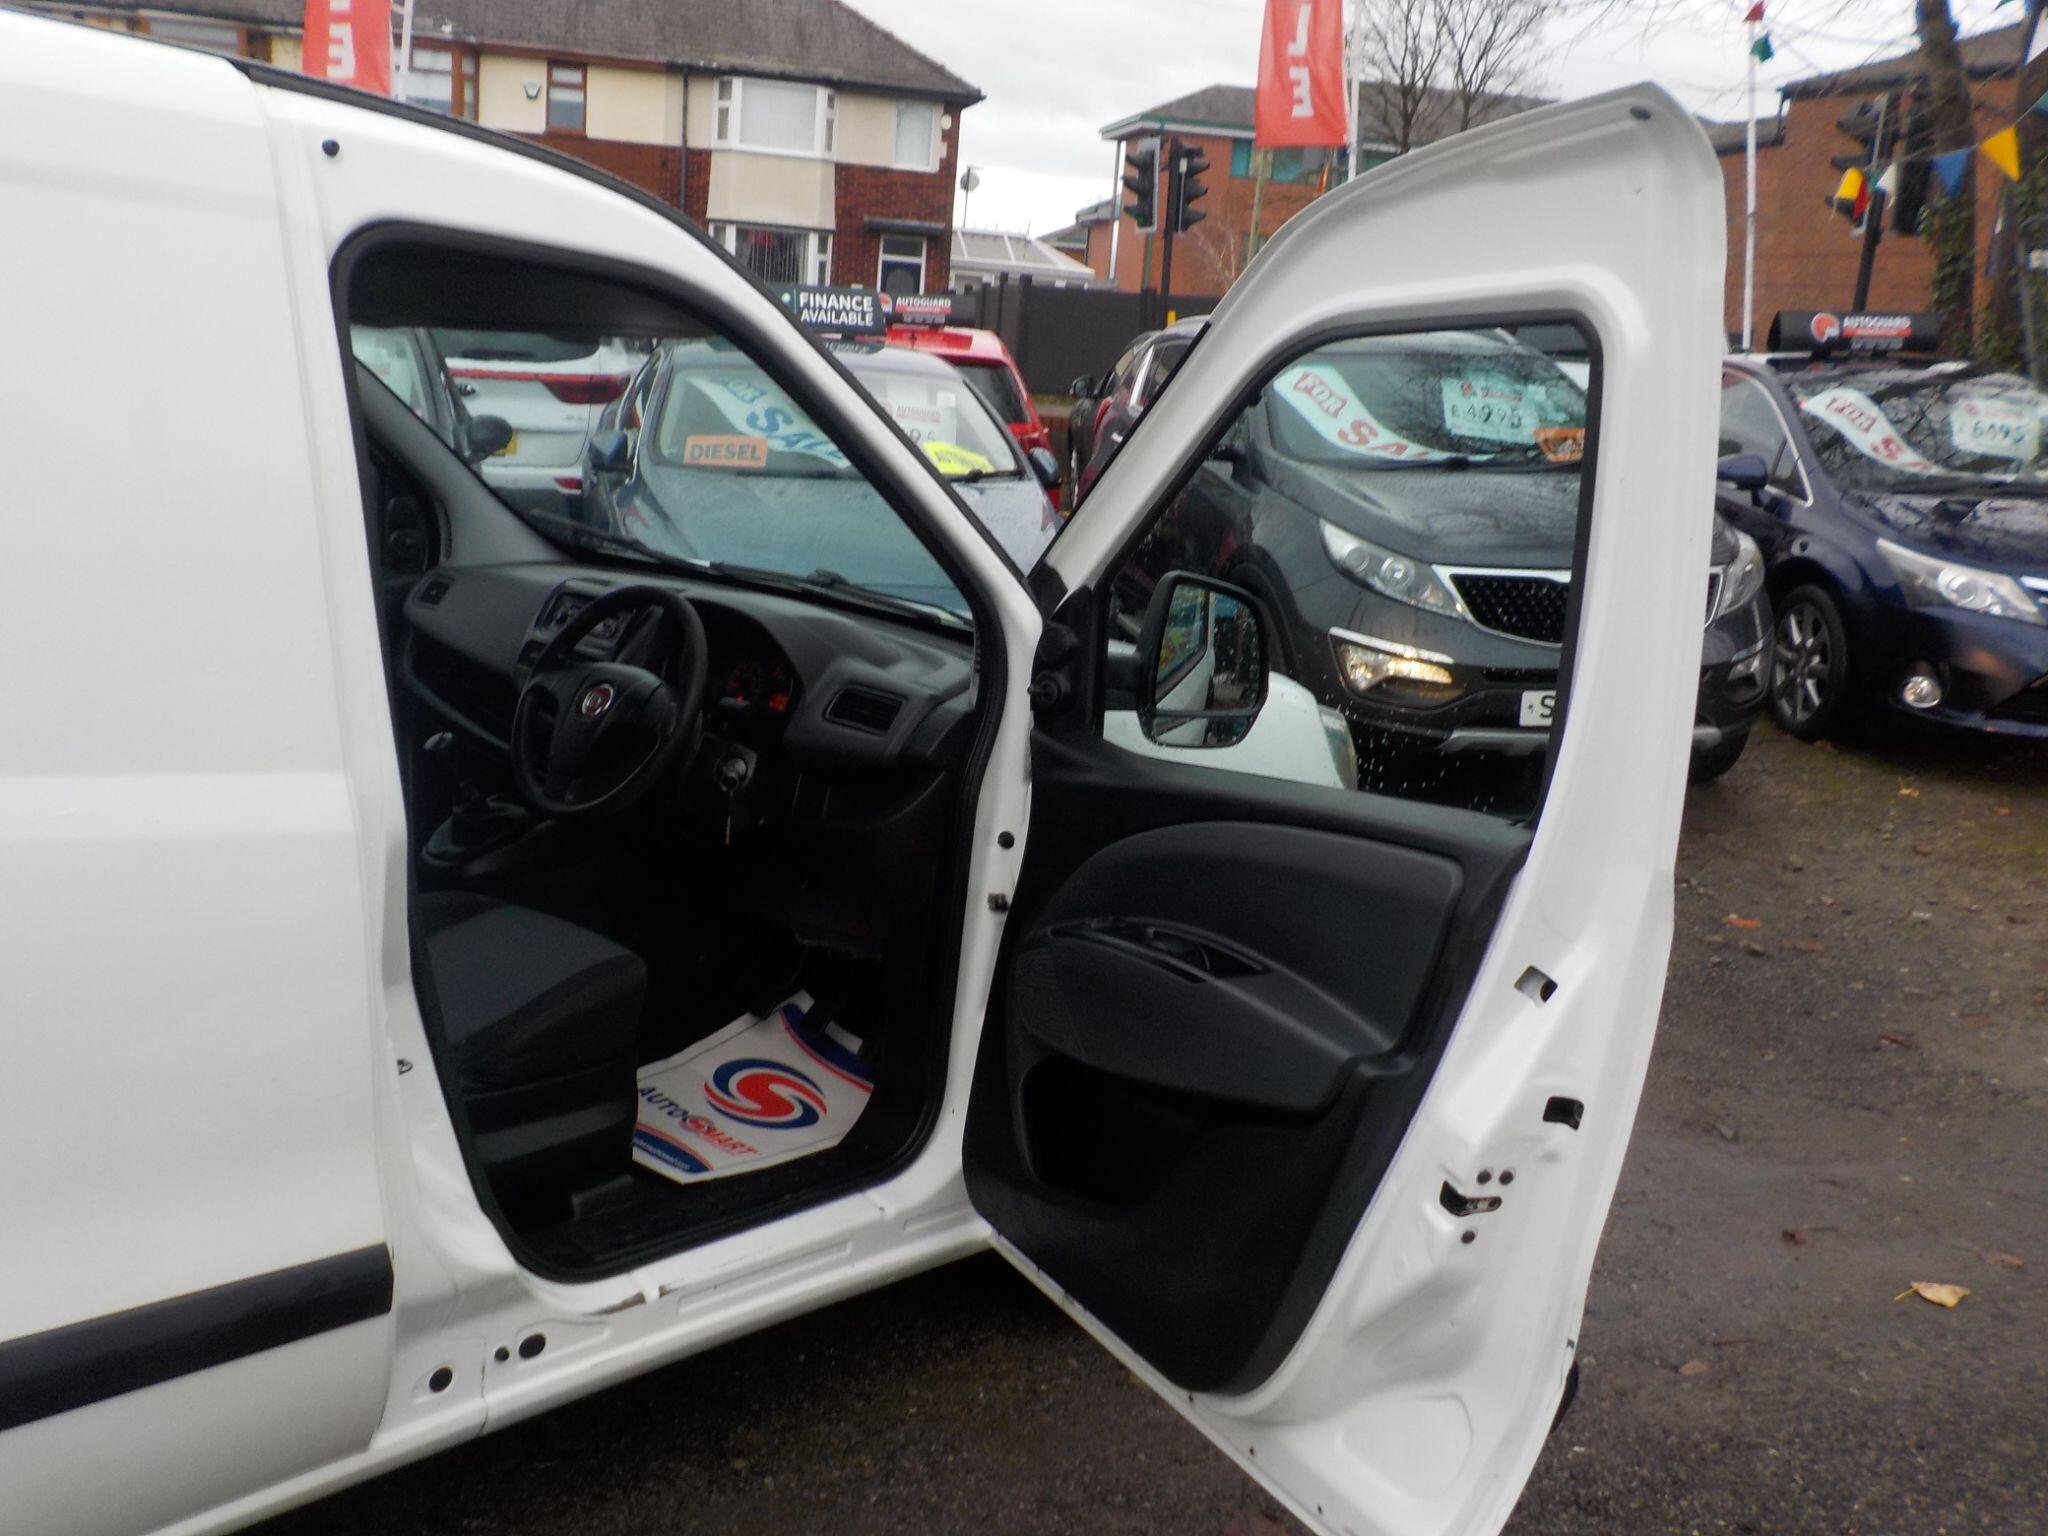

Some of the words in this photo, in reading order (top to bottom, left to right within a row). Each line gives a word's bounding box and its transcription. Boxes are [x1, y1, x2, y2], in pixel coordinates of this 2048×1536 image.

[799, 291, 874, 313] FINANCE
[895, 295, 952, 308] AUTOGUARD
[800, 308, 875, 327] AVAILABLE
[1292, 371, 1348, 419] FOR
[689, 443, 762, 462] DIESEL
